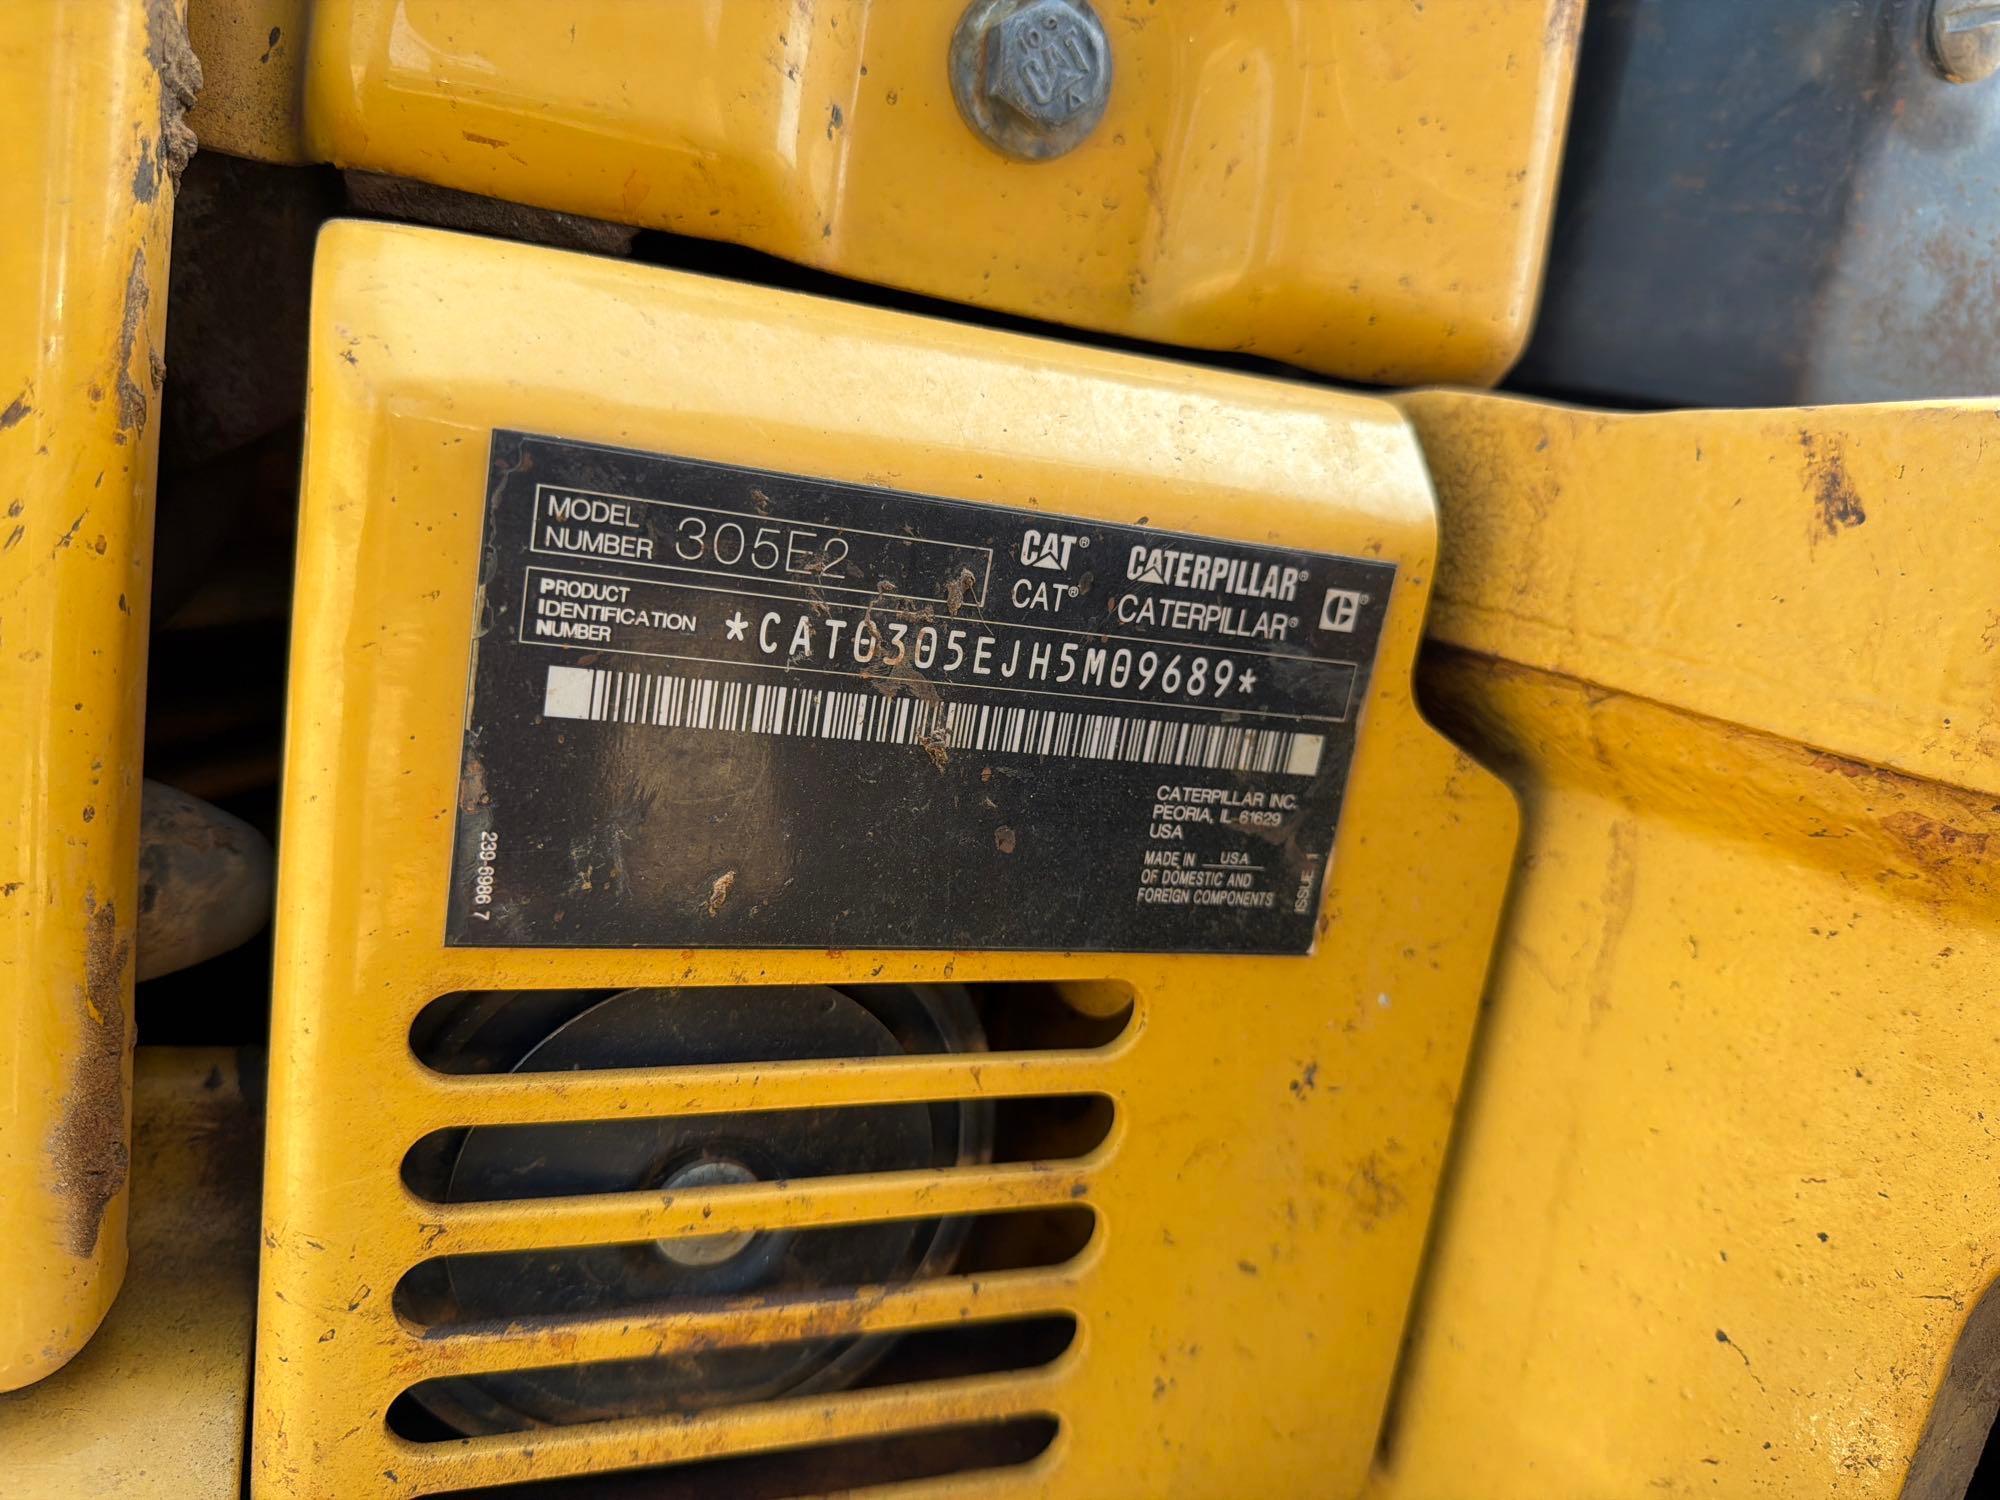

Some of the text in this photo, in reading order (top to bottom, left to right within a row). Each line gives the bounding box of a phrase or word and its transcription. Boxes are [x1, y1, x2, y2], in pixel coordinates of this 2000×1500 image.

[547, 494, 640, 528] MODEL
[544, 525, 654, 560] NUMBER
[675, 517, 849, 579] 305E2
[540, 577, 631, 603] PRODUCT
[537, 598, 698, 632] IDENTIFICATION
[535, 619, 612, 642] NUMBER
[1156, 785, 1298, 810] CATERPILLAR INC.
[1152, 804, 1282, 827] PEORIA, IL 61629
[1149, 823, 1184, 840] USA
[475, 830, 499, 905] 239-6986
[1144, 850, 1249, 867] MADE IN USA
[1140, 868, 1252, 888] OF DOMESTIC AND
[1136, 887, 1275, 907] FOREIGN COMPONENTS
[1294, 869, 1315, 913] ISSUE
